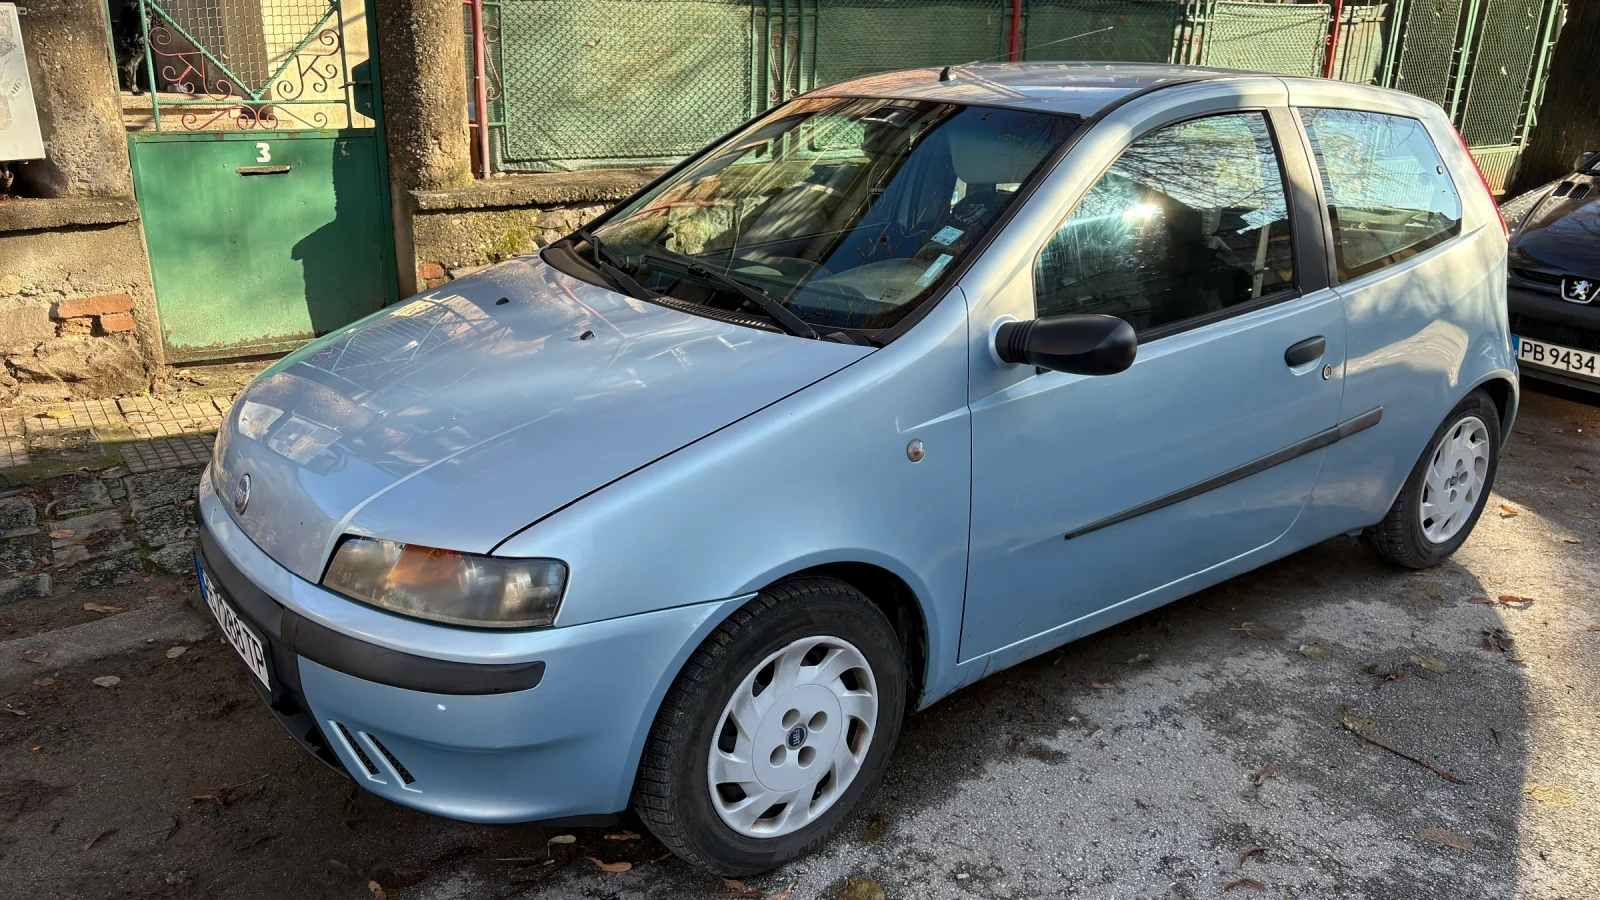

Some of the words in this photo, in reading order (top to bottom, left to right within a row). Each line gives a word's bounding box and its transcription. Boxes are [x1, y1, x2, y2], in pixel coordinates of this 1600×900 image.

[256, 142, 271, 163] 3
[1521, 341, 1545, 362] PB
[1549, 347, 1595, 374] 9434
[242, 627, 264, 676] TP
